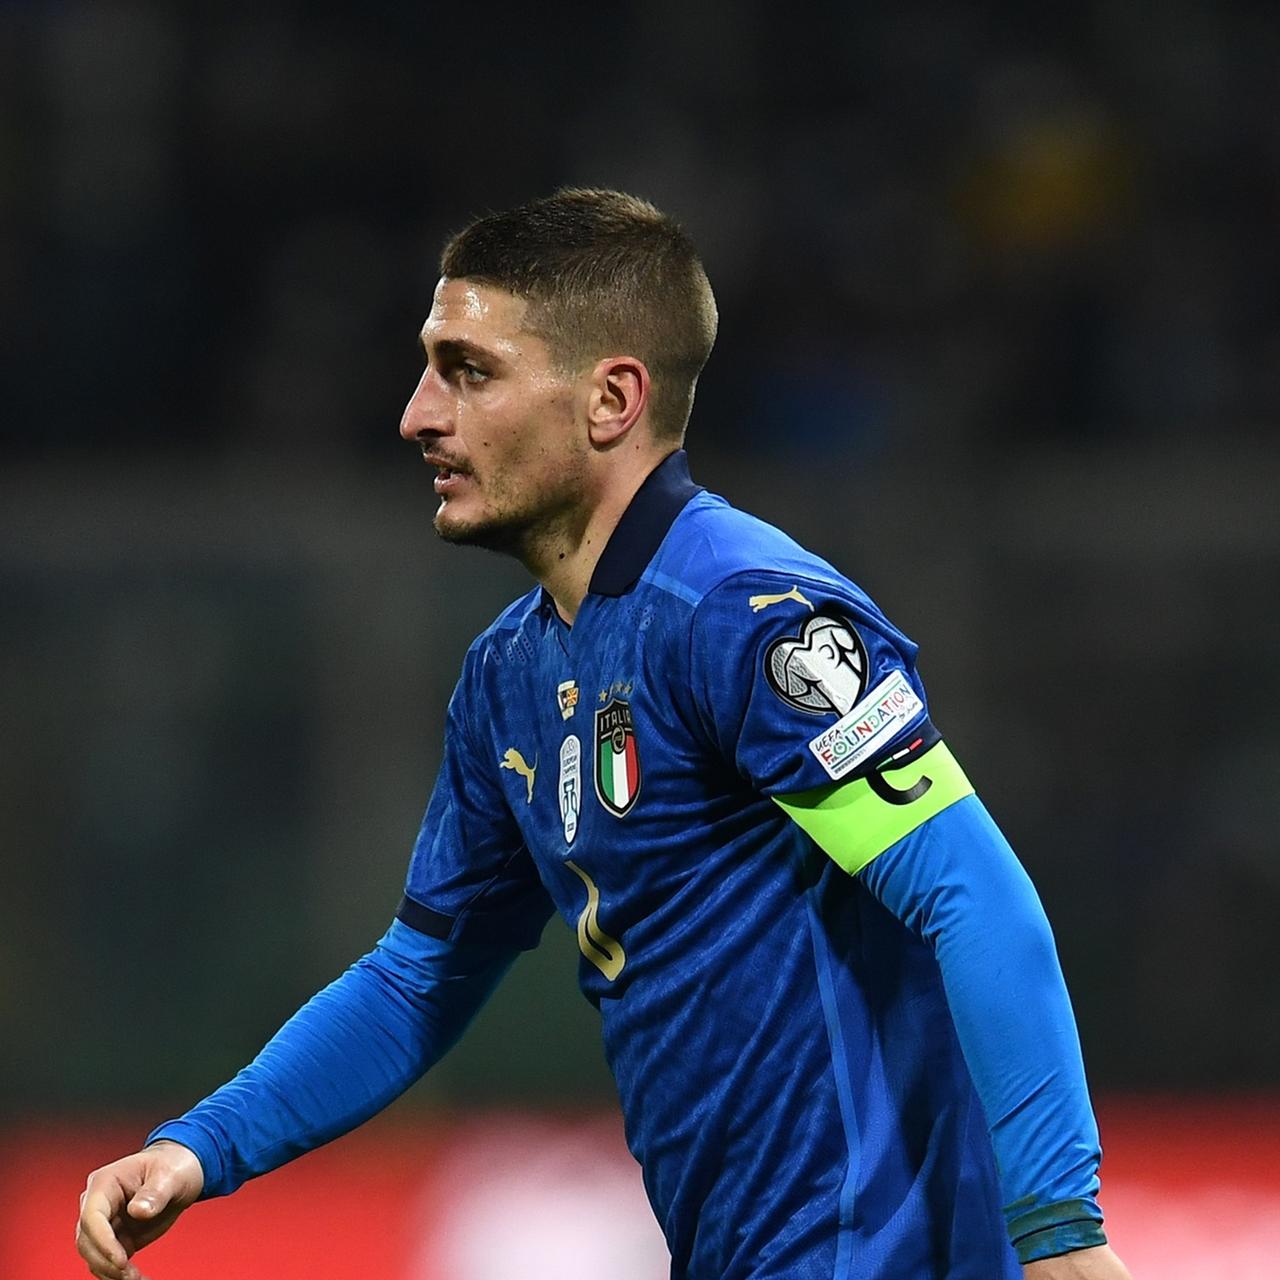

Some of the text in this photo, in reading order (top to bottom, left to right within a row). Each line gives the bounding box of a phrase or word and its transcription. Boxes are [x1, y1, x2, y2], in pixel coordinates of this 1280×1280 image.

[600, 709, 632, 733] ITALIA
[820, 683, 911, 765] FOUNDATION
[815, 727, 842, 752] UEFA
